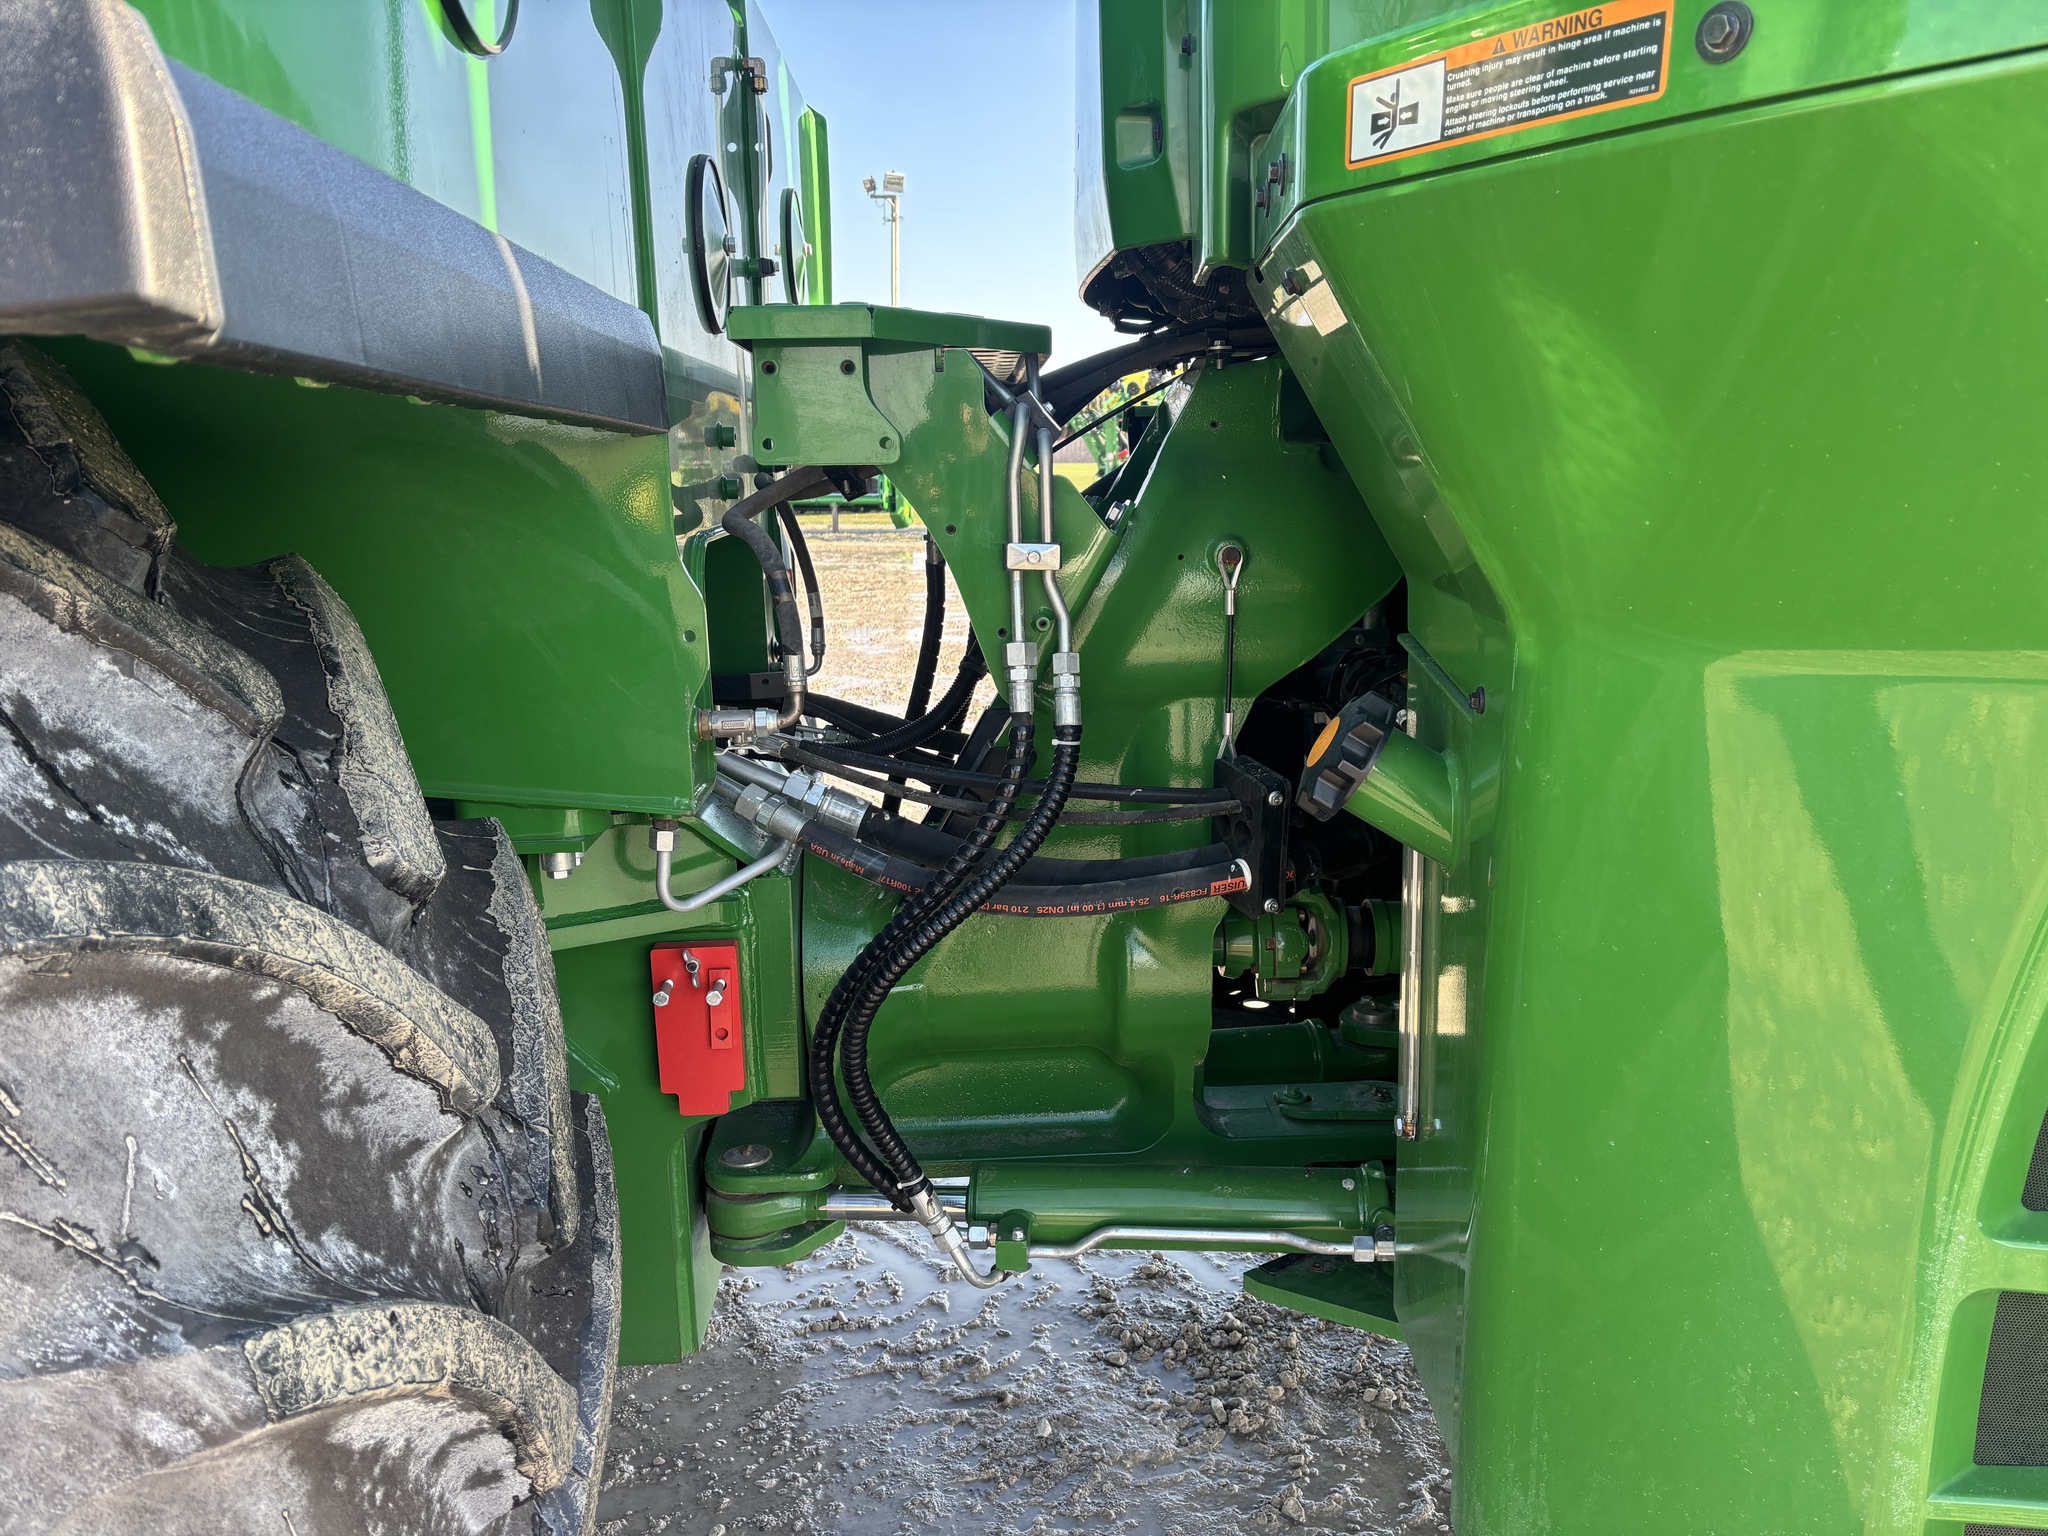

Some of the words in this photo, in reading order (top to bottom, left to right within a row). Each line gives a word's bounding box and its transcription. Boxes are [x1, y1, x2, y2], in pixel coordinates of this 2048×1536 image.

[1513, 9, 1602, 49] WARNING
[1447, 66, 1480, 82] Crushing
[1482, 60, 1503, 73] injury
[1505, 55, 1521, 65] may
[1523, 48, 1547, 61] result
[1548, 45, 1556, 54] in
[1558, 39, 1581, 51] hinge
[1583, 33, 1602, 45] area
[1604, 30, 1611, 39] if
[1612, 21, 1650, 37] machine
[1652, 18, 1662, 27] is
[1446, 94, 1464, 104] Make
[1466, 89, 1483, 100] sure
[1484, 82, 1509, 96] people
[1511, 78, 1523, 87] are
[1525, 73, 1544, 84] clear
[1546, 68, 1555, 78] of
[1556, 61, 1591, 76] machine
[1593, 53, 1621, 67] before
[1623, 44, 1658, 59] starting
[1447, 77, 1472, 91] turned.
[1444, 114, 1467, 127] Attach
[1468, 108, 1497, 121] steering
[1498, 100, 1530, 114] lockouts
[1531, 93, 1556, 106] before
[1557, 82, 1601, 101] performing
[1603, 75, 1634, 89] service
[1636, 70, 1656, 81] near
[1445, 102, 1470, 114] engine
[1471, 99, 1479, 107] or
[1480, 92, 1508, 105] moving
[1509, 83, 1541, 98] steering
[1543, 76, 1569, 89] wheel.
[1444, 126, 1466, 136] center
[1467, 122, 1475, 131] of
[1476, 116, 1505, 128] machine
[1507, 113, 1515, 121] or
[1516, 101, 1563, 119] transporting
[1565, 98, 1576, 108] on
[1577, 97, 1583, 105] a
[1584, 90, 1608, 103] truck.
[810, 842, 829, 858] USA
[830, 852, 840, 863] in
[840, 857, 865, 875] Made
[880, 876, 912, 892] 100R17
[1213, 880, 1248, 893] UISER
[1130, 897, 1150, 907] 25.4
[1159, 888, 1208, 903] FC839R-16
[992, 903, 1009, 912] bar
[1010, 905, 1029, 914] 210
[1036, 905, 1064, 914] DN25
[1067, 904, 1080, 913] in)
[1082, 902, 1105, 912] (1.00
[1108, 900, 1127, 908] mm
